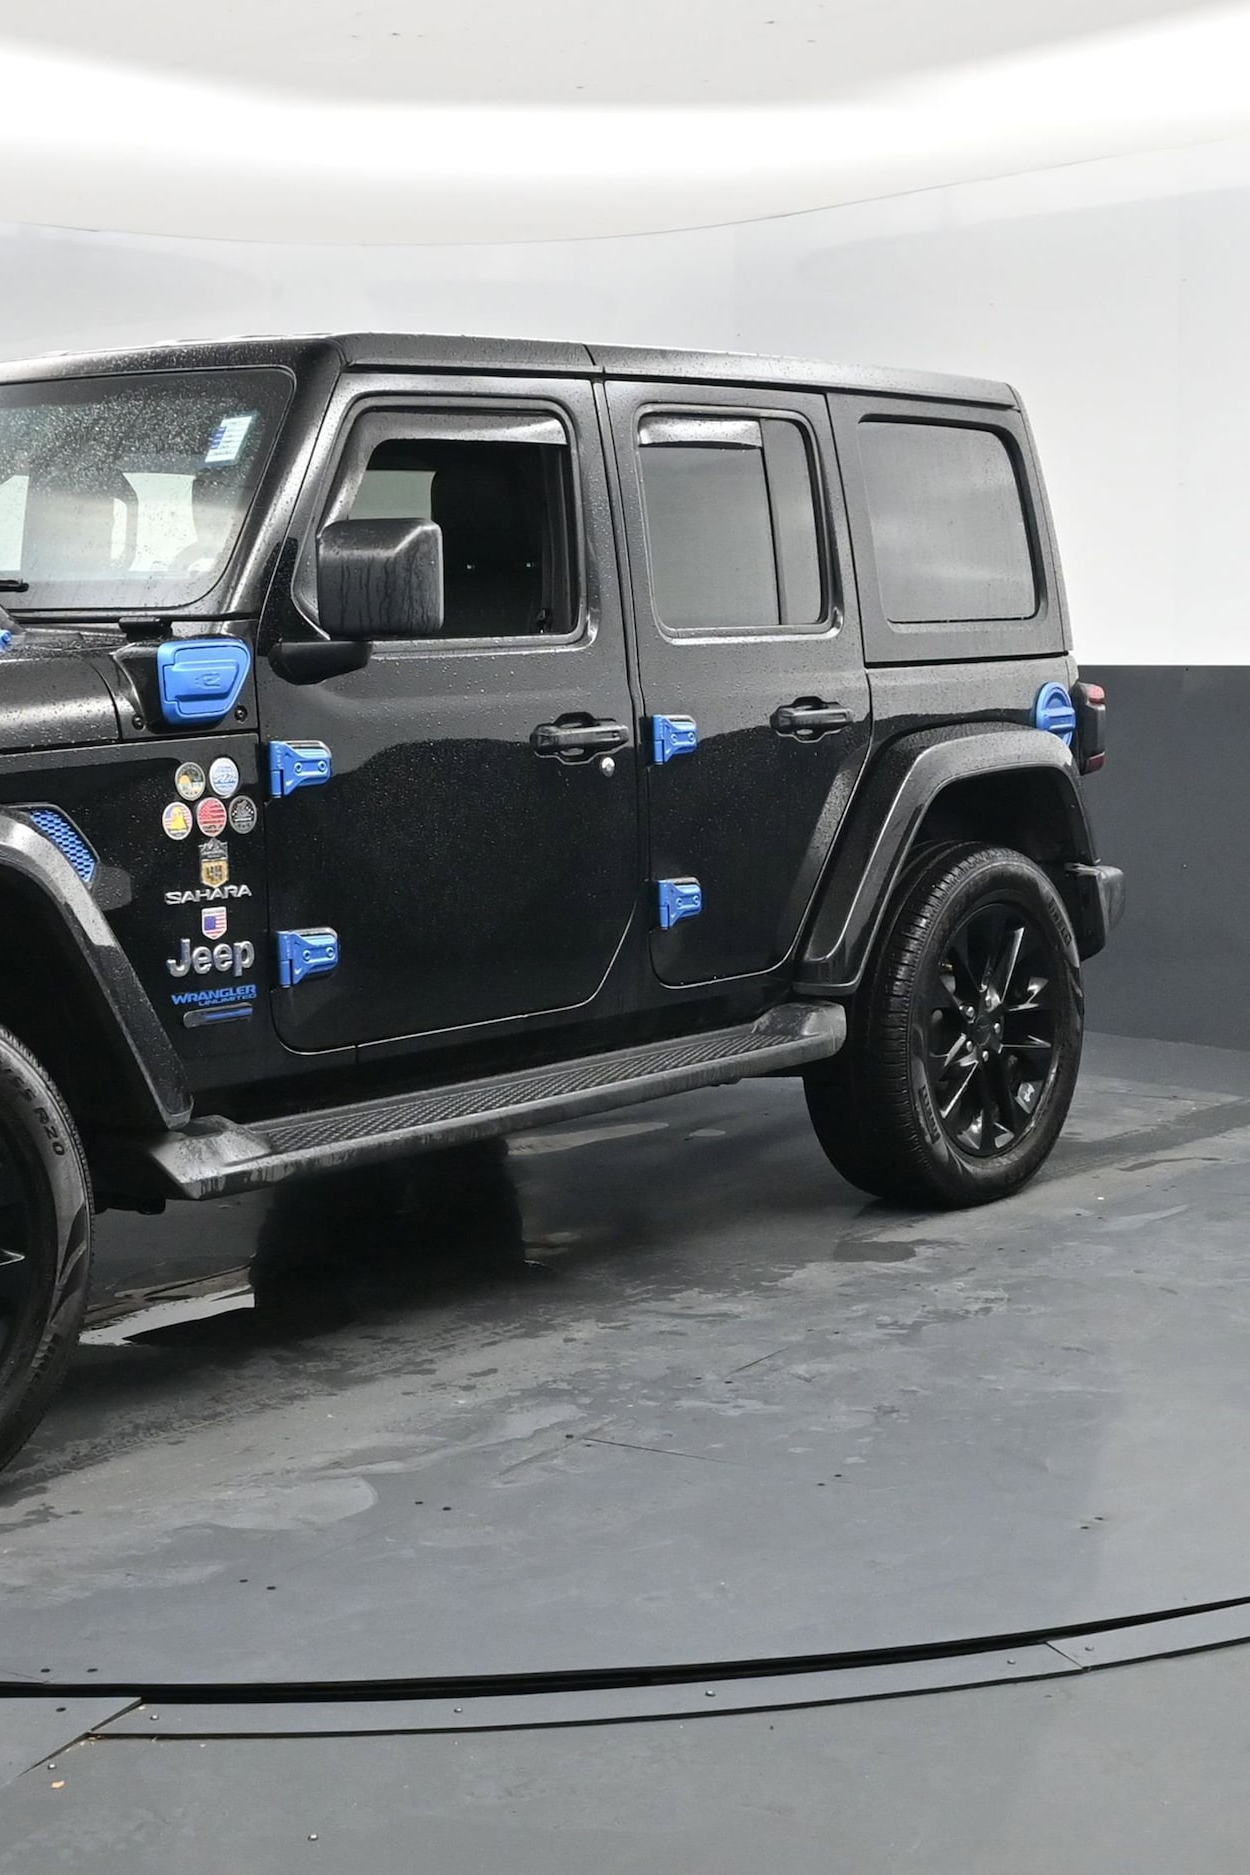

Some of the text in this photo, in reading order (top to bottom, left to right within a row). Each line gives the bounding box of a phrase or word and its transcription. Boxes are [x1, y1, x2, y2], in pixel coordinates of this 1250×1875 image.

[165, 884, 253, 905] SAHARA
[166, 937, 256, 978] Jeep
[171, 984, 257, 1006] WRANGLER
[198, 993, 258, 1007] UNLIMITED
[34, 1107, 66, 1156] R20
